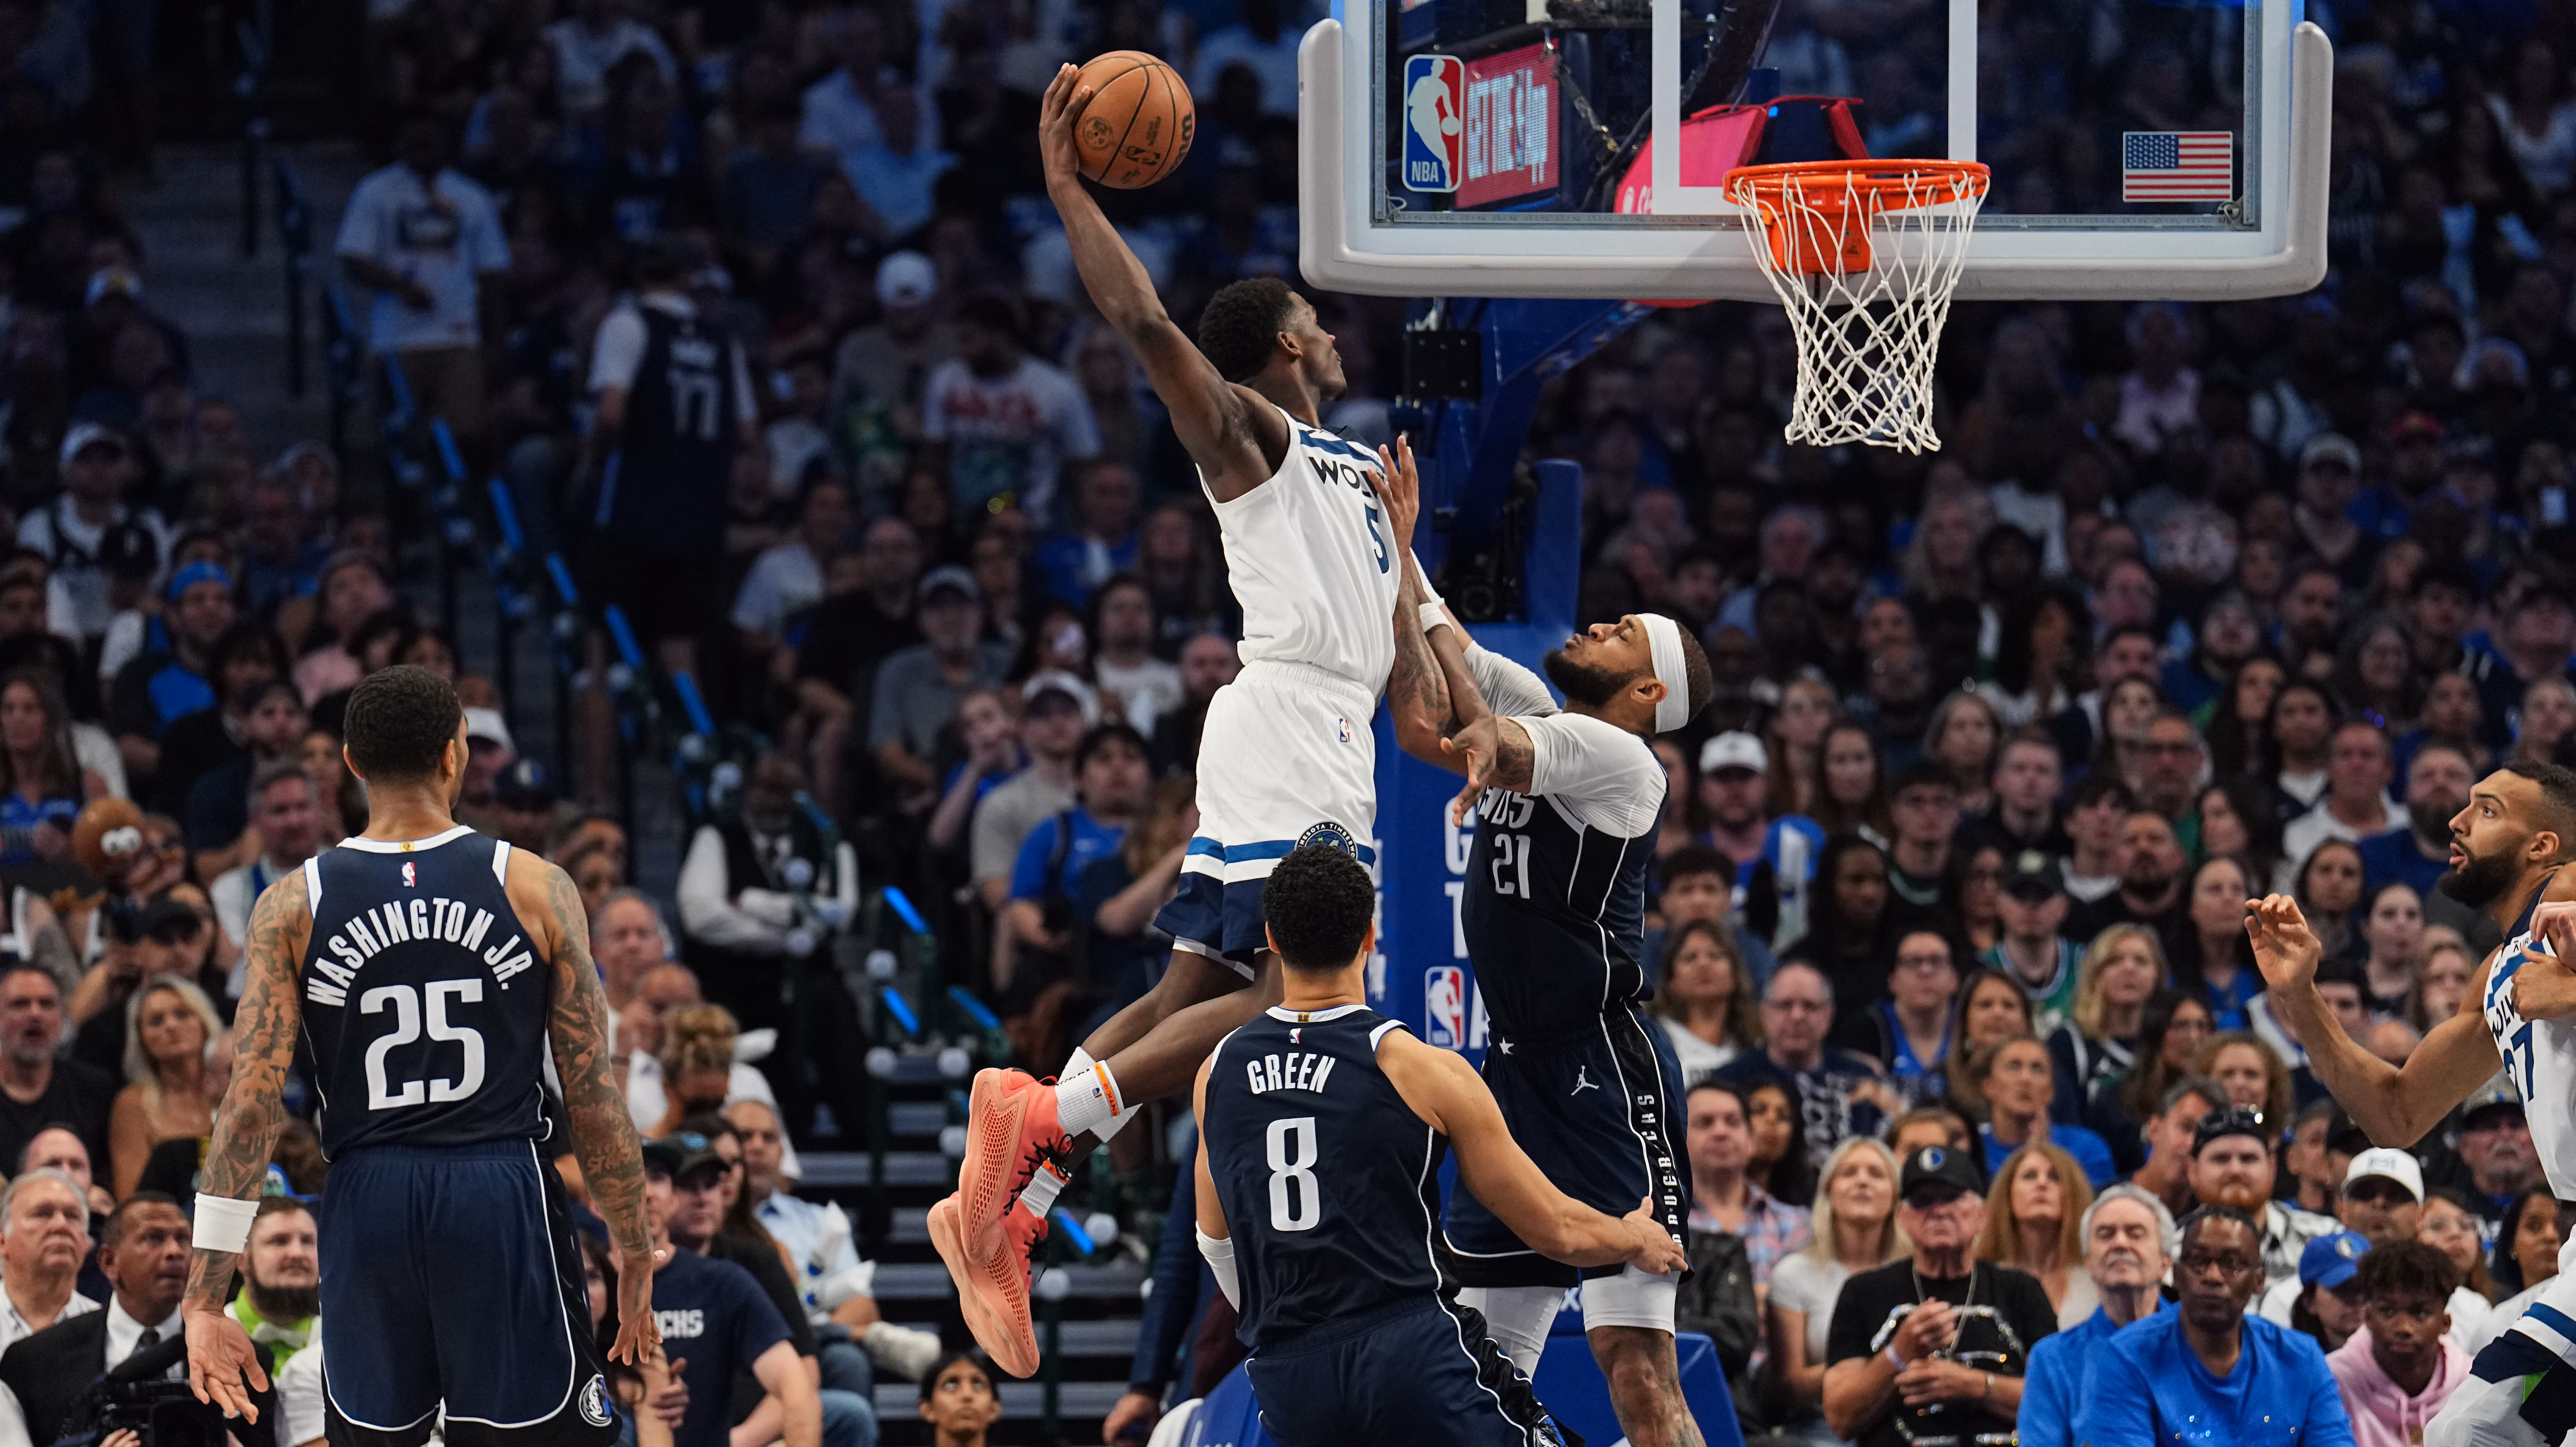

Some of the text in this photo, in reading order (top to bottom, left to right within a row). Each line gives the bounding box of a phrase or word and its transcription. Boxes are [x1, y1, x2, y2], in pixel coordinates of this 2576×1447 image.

[1411, 161, 1439, 183] NBA
[1364, 502, 1389, 574] 5
[1493, 833, 1531, 899] 21
[307, 897, 533, 1007] WASHINGTON JR.
[361, 979, 485, 1111] 25
[1247, 1052, 1336, 1095] GREEN
[1266, 1117, 1320, 1232] 8
